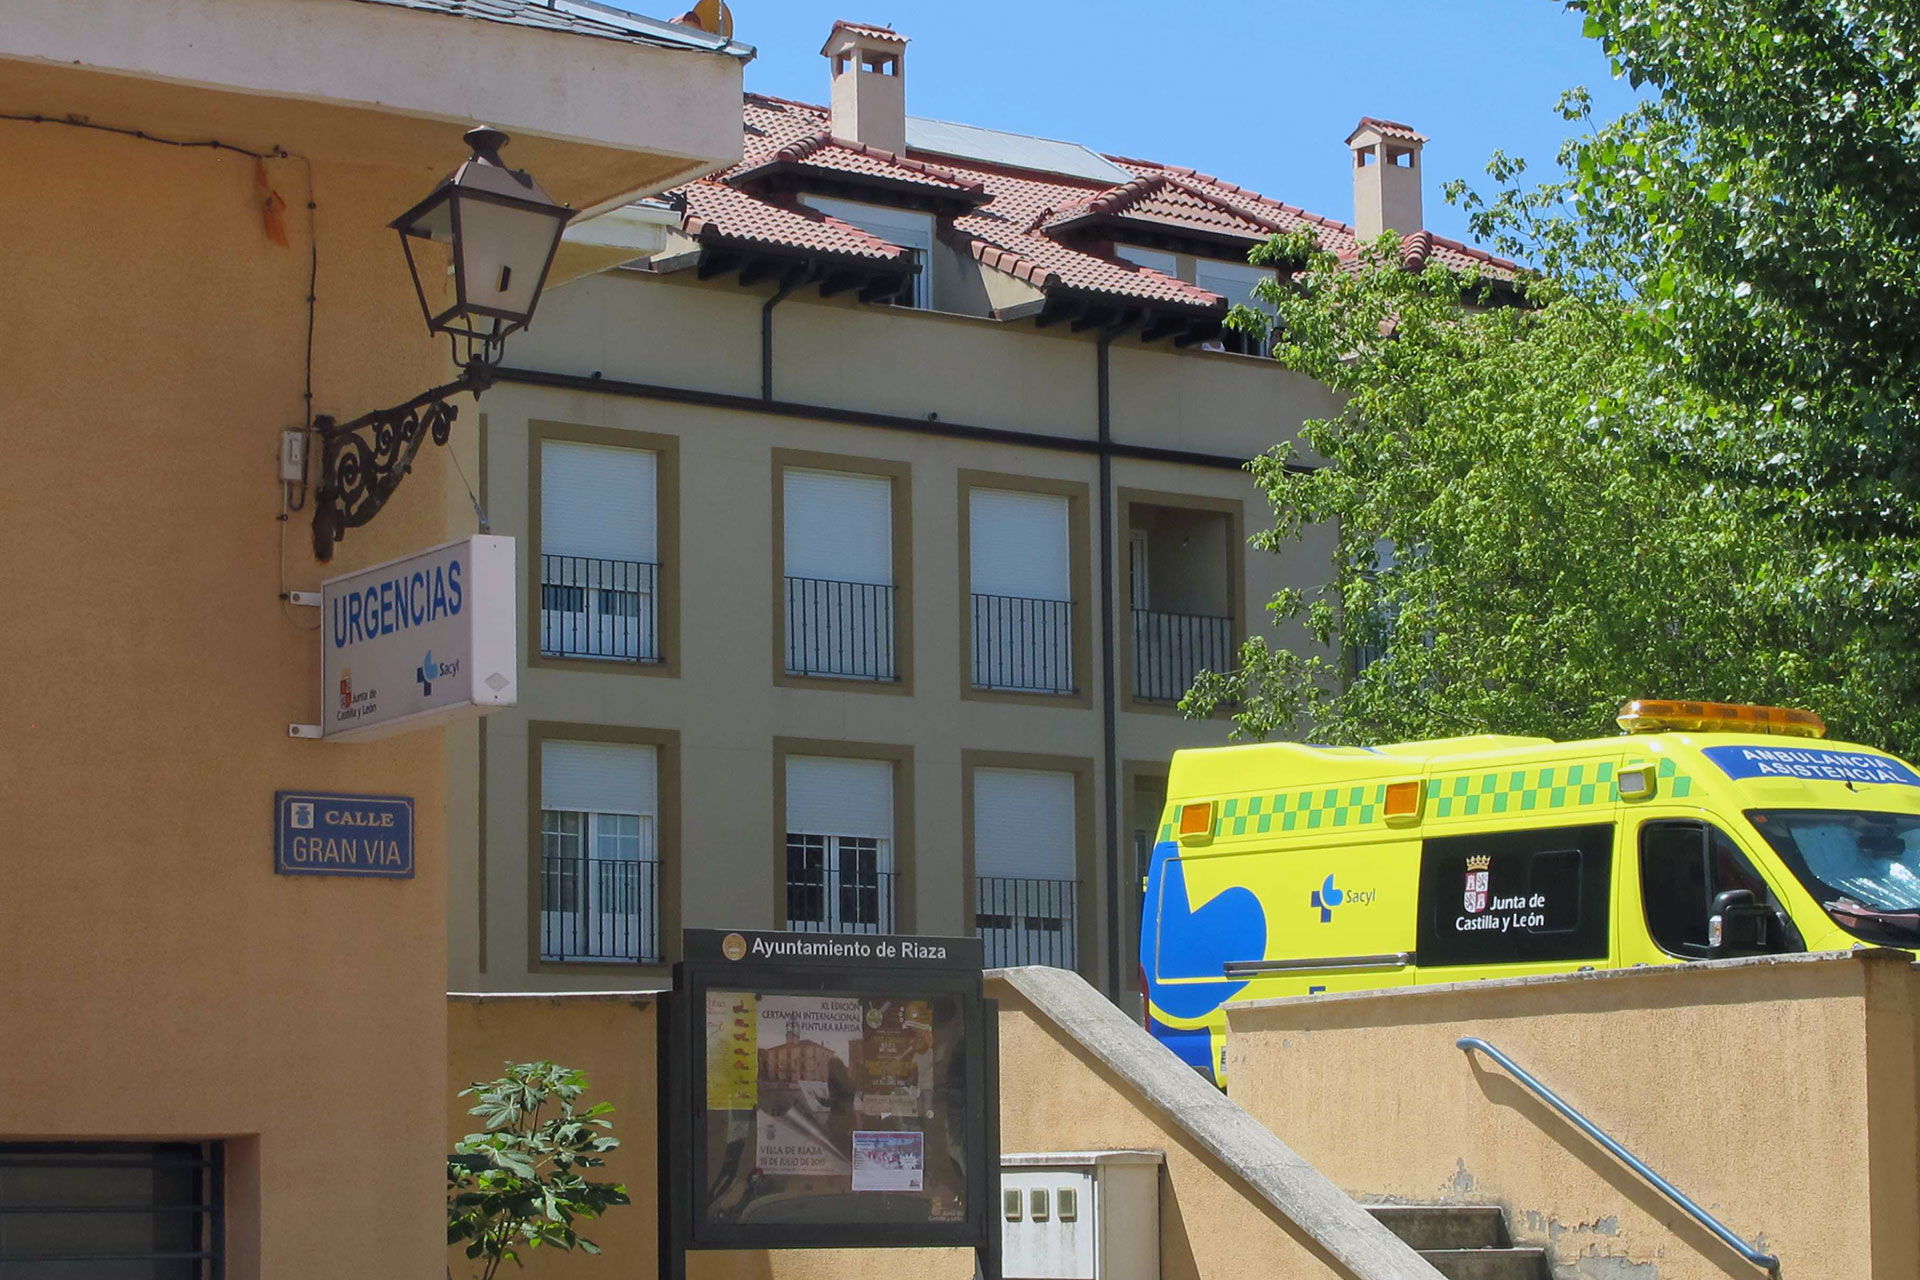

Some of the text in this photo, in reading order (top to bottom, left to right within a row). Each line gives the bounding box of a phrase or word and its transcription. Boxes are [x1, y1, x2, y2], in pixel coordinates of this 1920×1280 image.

[334, 560, 462, 649] URGENCIAS
[440, 659, 459, 678] Sacyl
[1742, 749, 1894, 770] AMBULANCIA
[1758, 762, 1908, 783] ASISTENCIAL
[325, 810, 395, 827] CALLE
[293, 836, 357, 863] GRAN
[1346, 888, 1376, 906] Sacyl
[1490, 893, 1546, 911] Junta de
[1455, 912, 1545, 933] Castilla y León
[752, 937, 947, 959] Ayuntamiento de Riaza
[762, 1010, 861, 1022] CERTAMEN INTERNACIONAL
